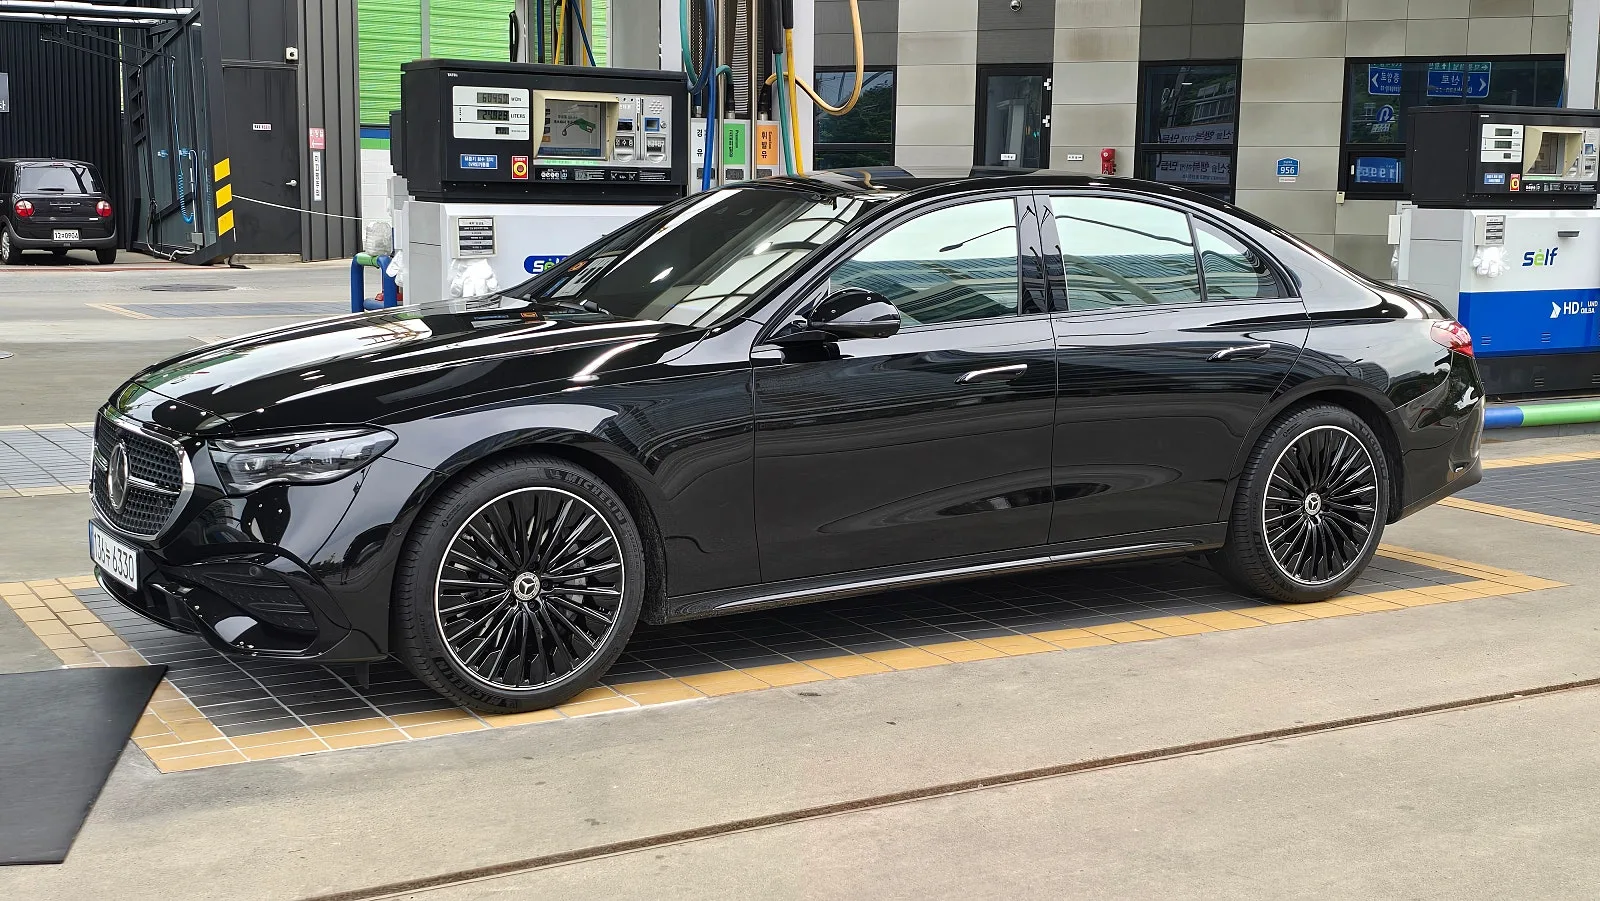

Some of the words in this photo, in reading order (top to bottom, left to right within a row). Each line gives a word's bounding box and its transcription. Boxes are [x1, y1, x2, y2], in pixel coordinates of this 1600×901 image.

[1280, 166, 1295, 174] 956
[1563, 301, 1579, 315] HD
[565, 472, 627, 525] MICHELIN
[113, 545, 135, 582] 6330
